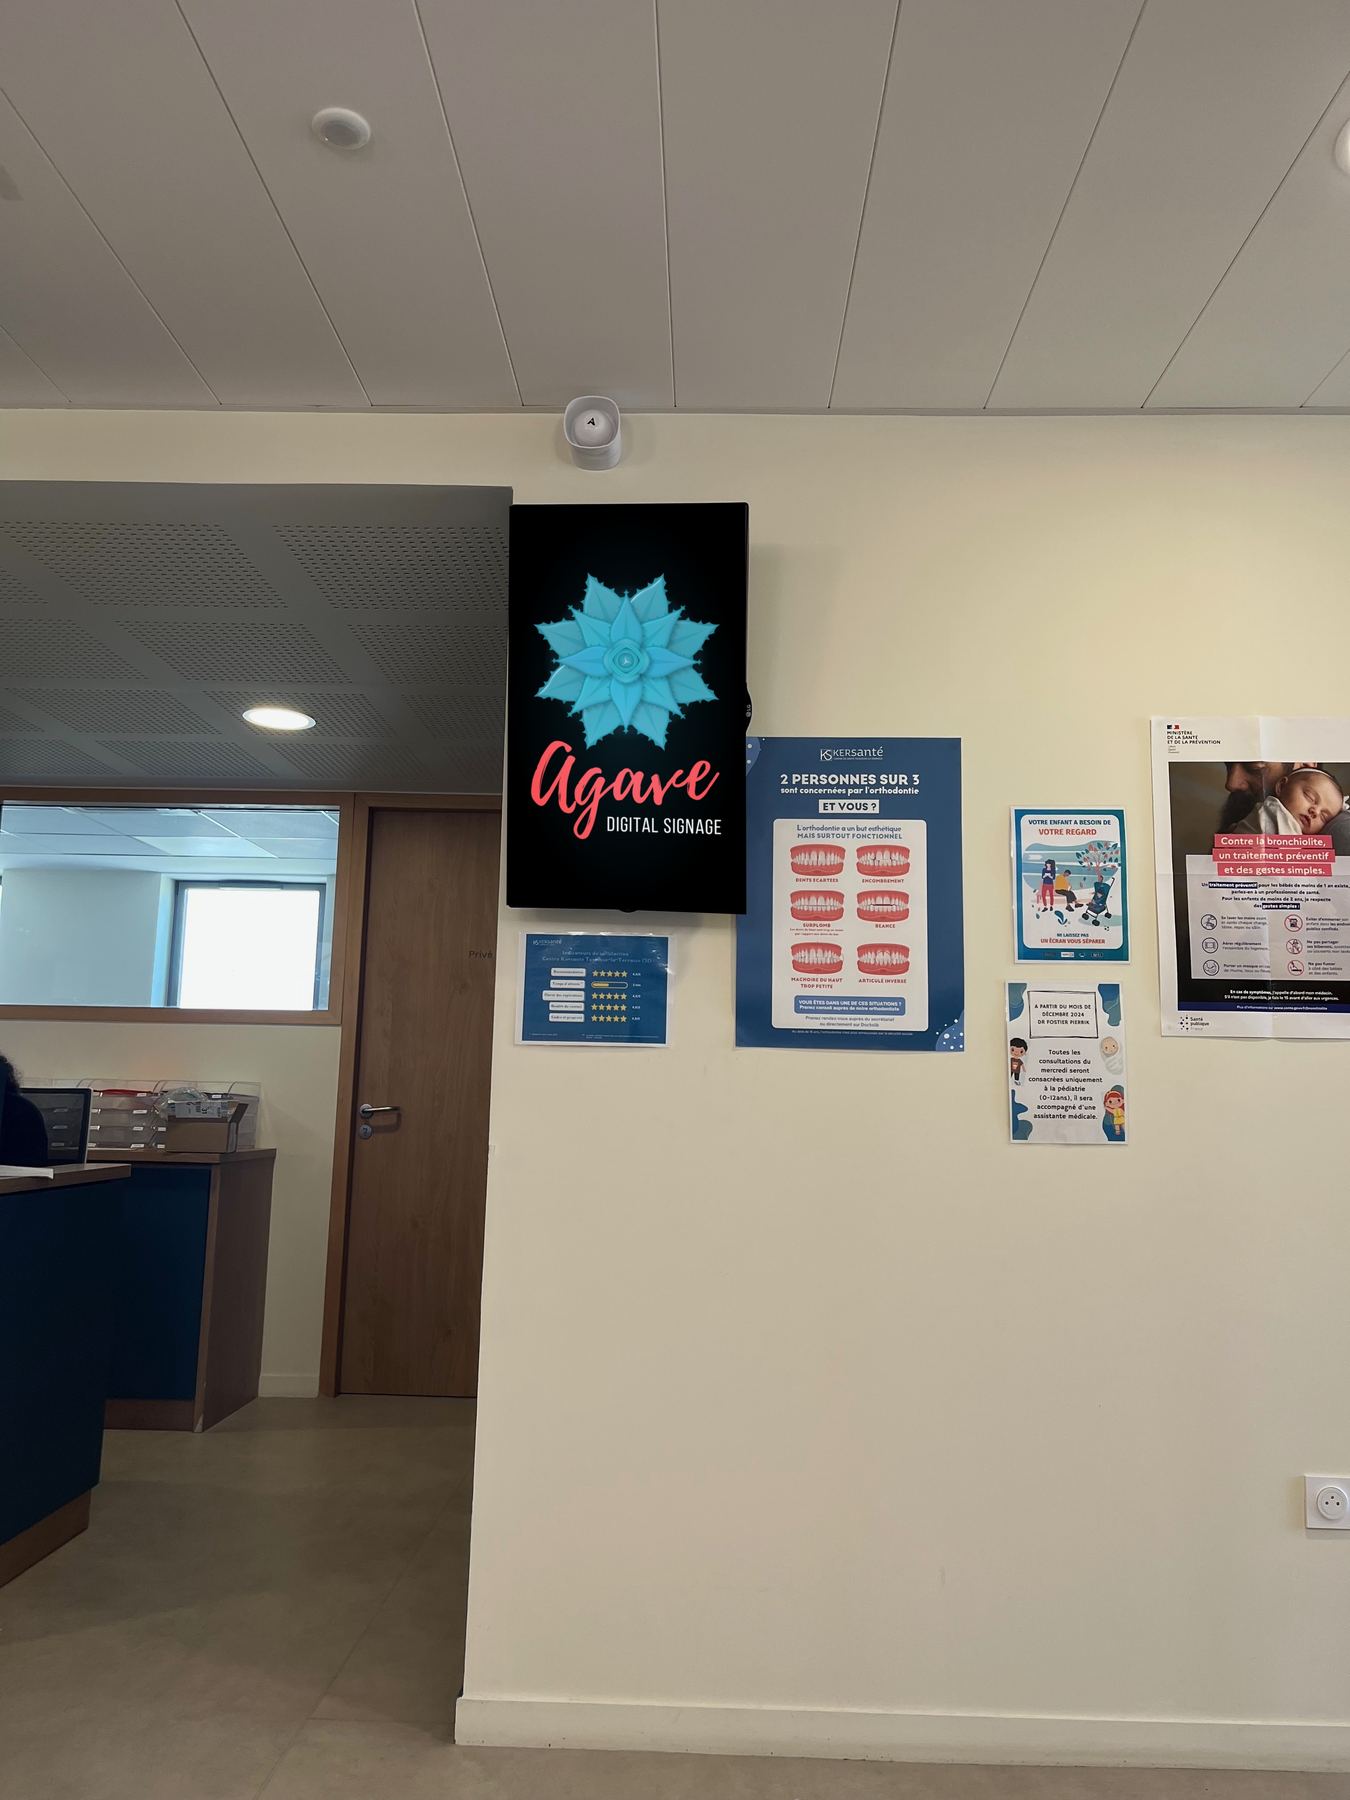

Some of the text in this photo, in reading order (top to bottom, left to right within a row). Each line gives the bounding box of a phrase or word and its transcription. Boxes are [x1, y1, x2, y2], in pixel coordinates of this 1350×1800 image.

[780, 774, 920, 785] 2 PERSONNES SUR 3
[531, 740, 720, 840] Agave
[848, 787, 863, 796] par
[865, 787, 920, 795] l'orthodontie
[823, 803, 877, 811] ET VOUS ?
[607, 816, 722, 835] DIGITAL SIGNAGE
[1221, 837, 1326, 847] Contre la bronchiolite,
[1233, 851, 1283, 860] traitement
[1286, 851, 1329, 862] préventif
[1224, 865, 1325, 877] et des gestes simples.
[469, 950, 493, 959] Privé
[1037, 1104, 1076, 1112] accompagné
[1068, 1113, 1098, 1121] médicale.
